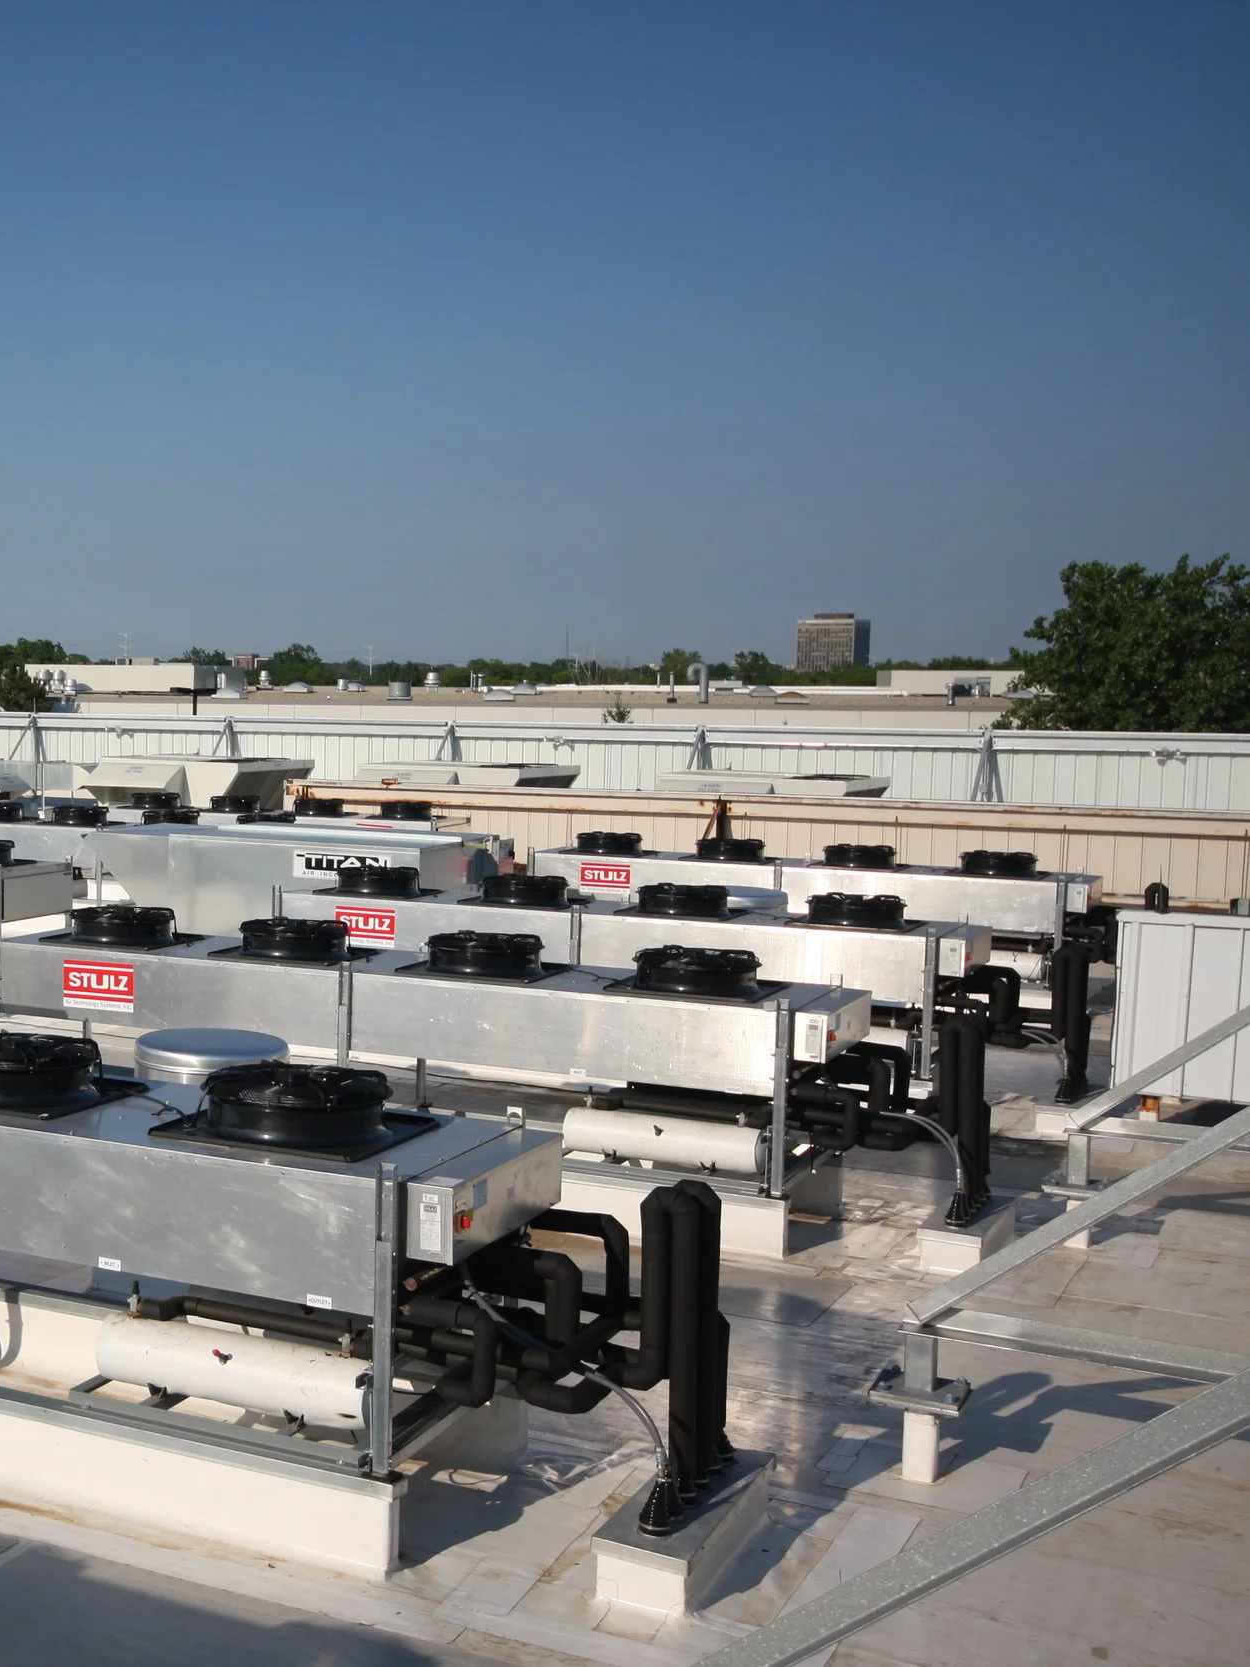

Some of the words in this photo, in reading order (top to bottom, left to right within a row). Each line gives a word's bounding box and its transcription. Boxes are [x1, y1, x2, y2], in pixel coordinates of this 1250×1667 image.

[302, 853, 388, 869] TITAN
[584, 869, 627, 882] STULZ
[340, 915, 391, 931] STULZ
[68, 971, 129, 991] STULZ
[73, 1000, 99, 1008] Technology
